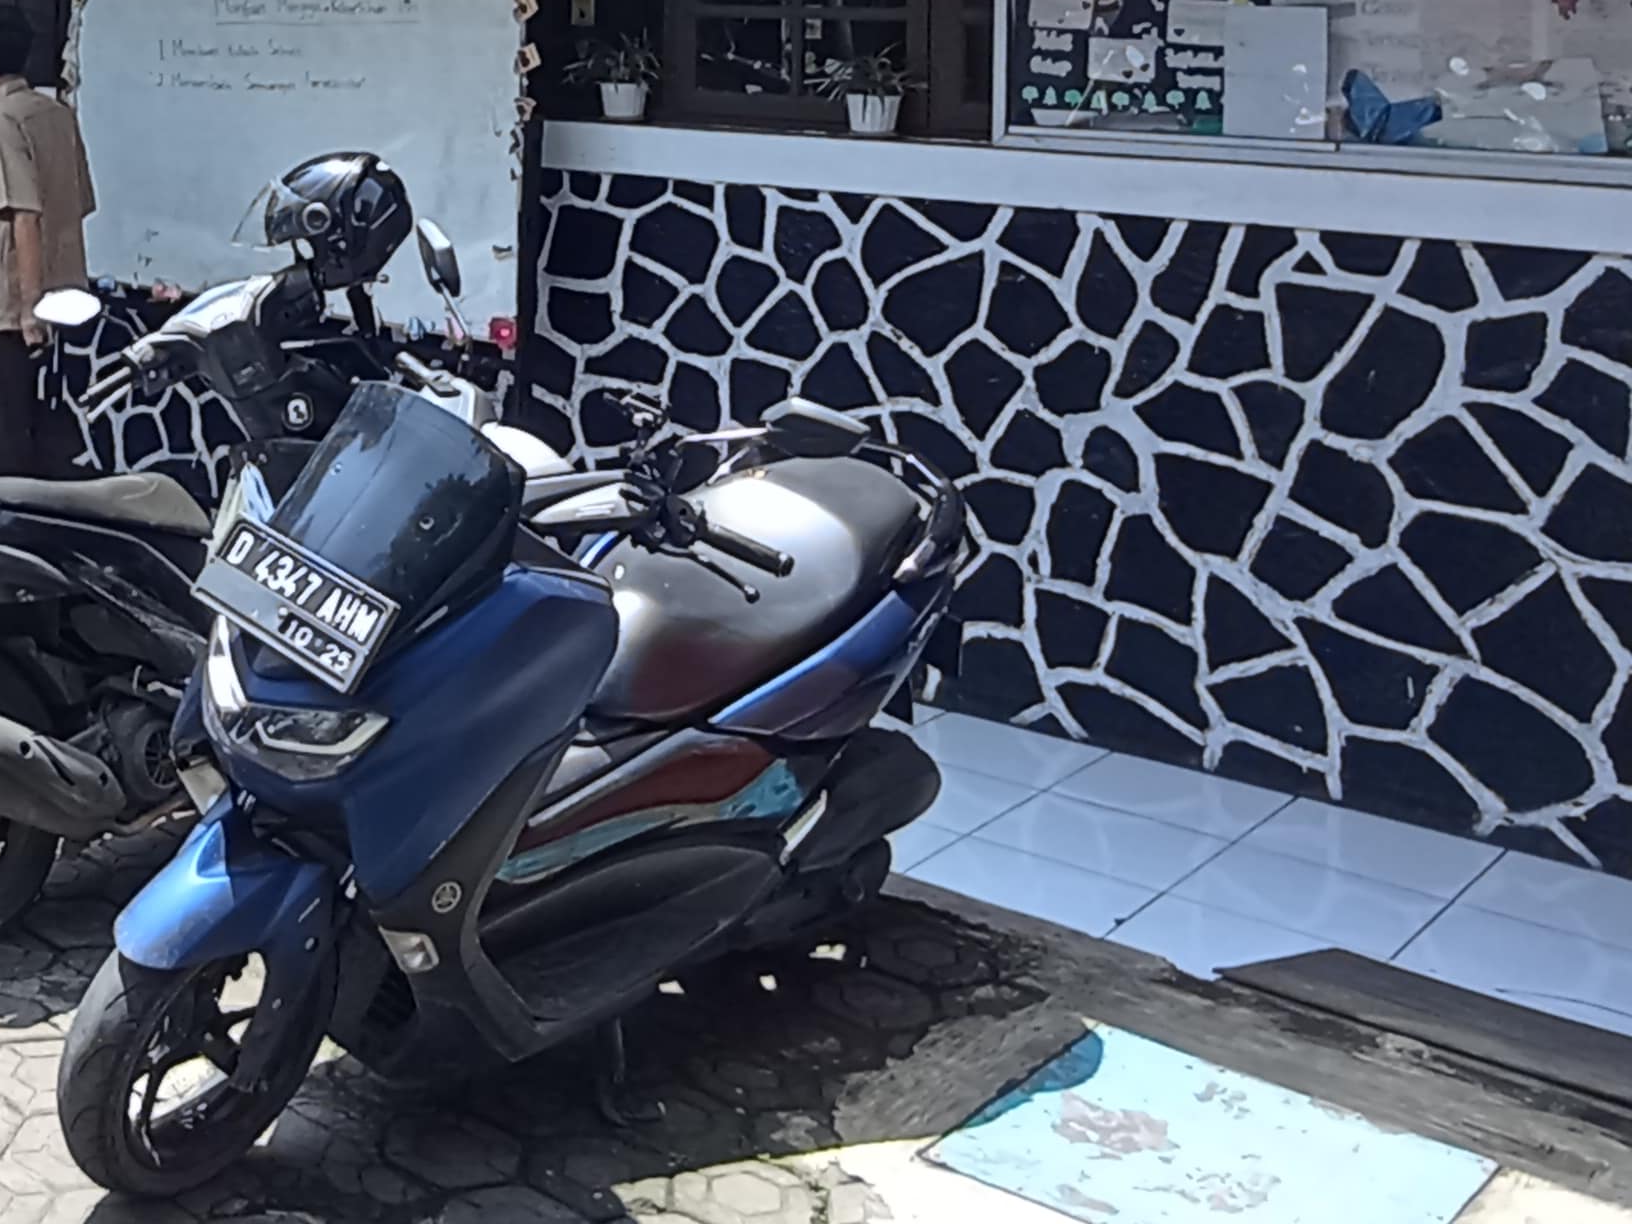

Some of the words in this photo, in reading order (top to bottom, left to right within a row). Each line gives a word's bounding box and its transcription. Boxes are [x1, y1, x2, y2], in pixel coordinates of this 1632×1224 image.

[226, 530, 256, 565] D
[255, 550, 323, 606] 4347
[317, 587, 380, 643] AHM
